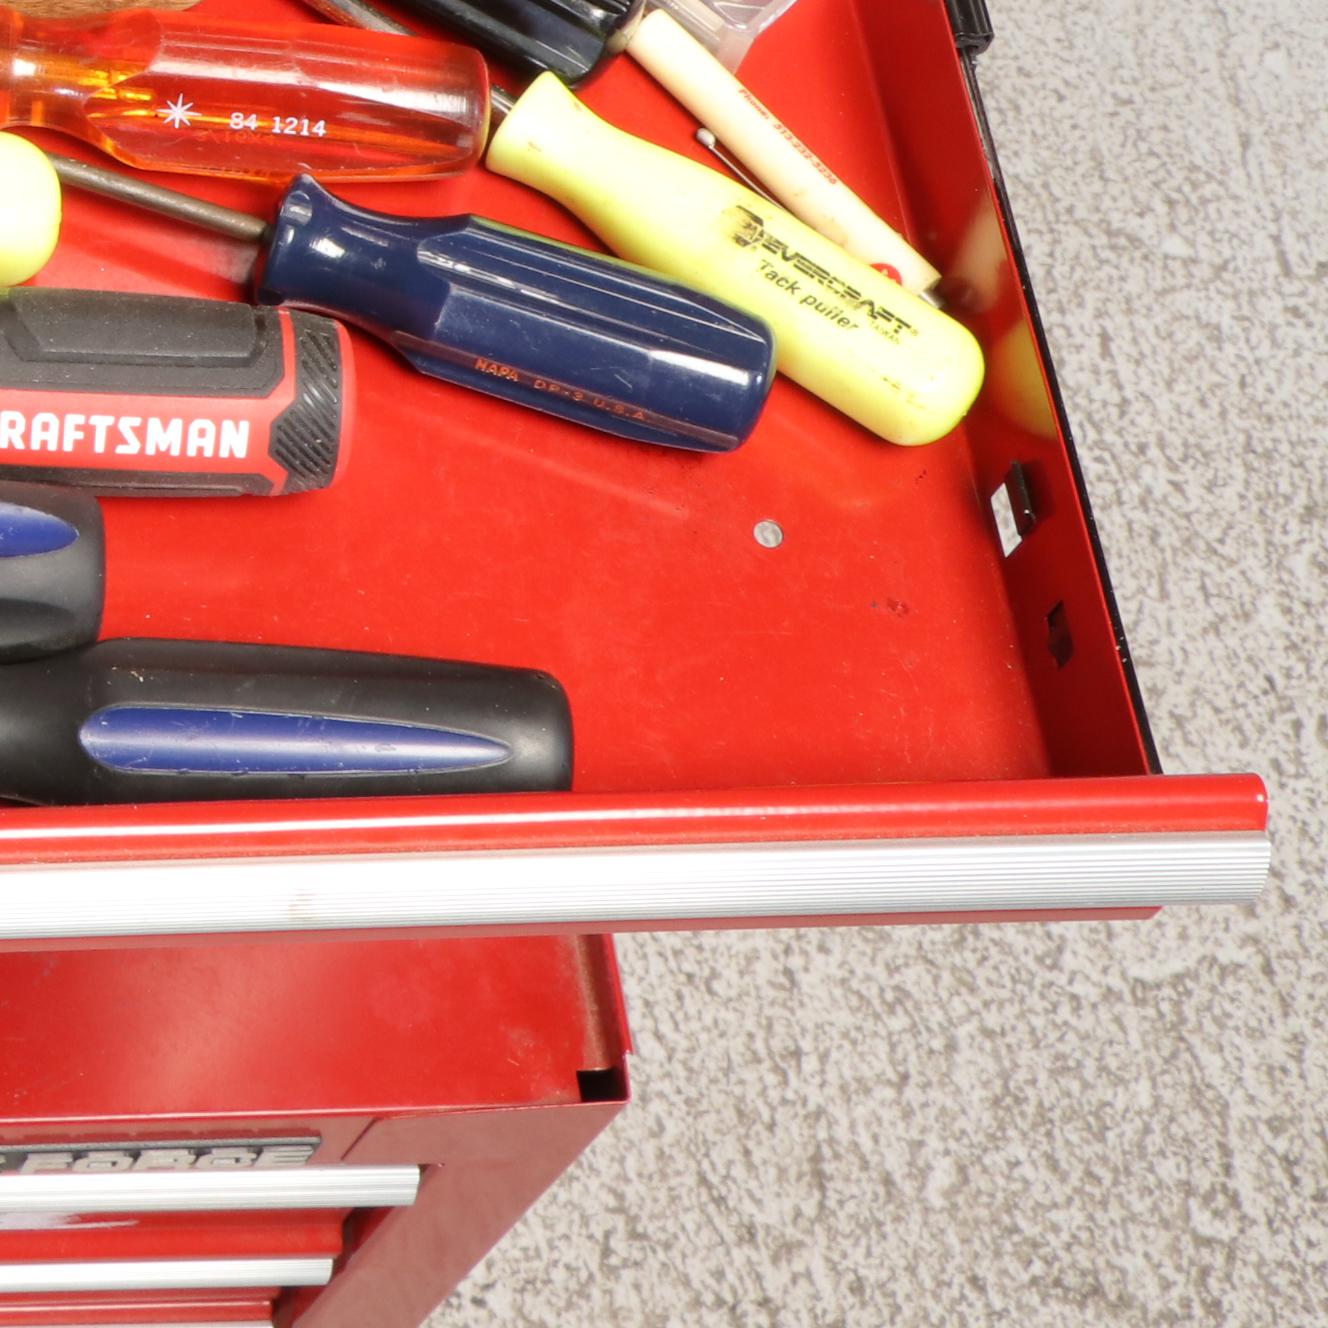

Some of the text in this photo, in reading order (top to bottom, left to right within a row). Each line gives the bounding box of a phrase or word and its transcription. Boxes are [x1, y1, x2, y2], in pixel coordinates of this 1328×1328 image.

[229, 112, 258, 131] 84
[271, 116, 326, 137] 1214
[759, 259, 801, 297] Tack
[475, 358, 519, 382] NAPA
